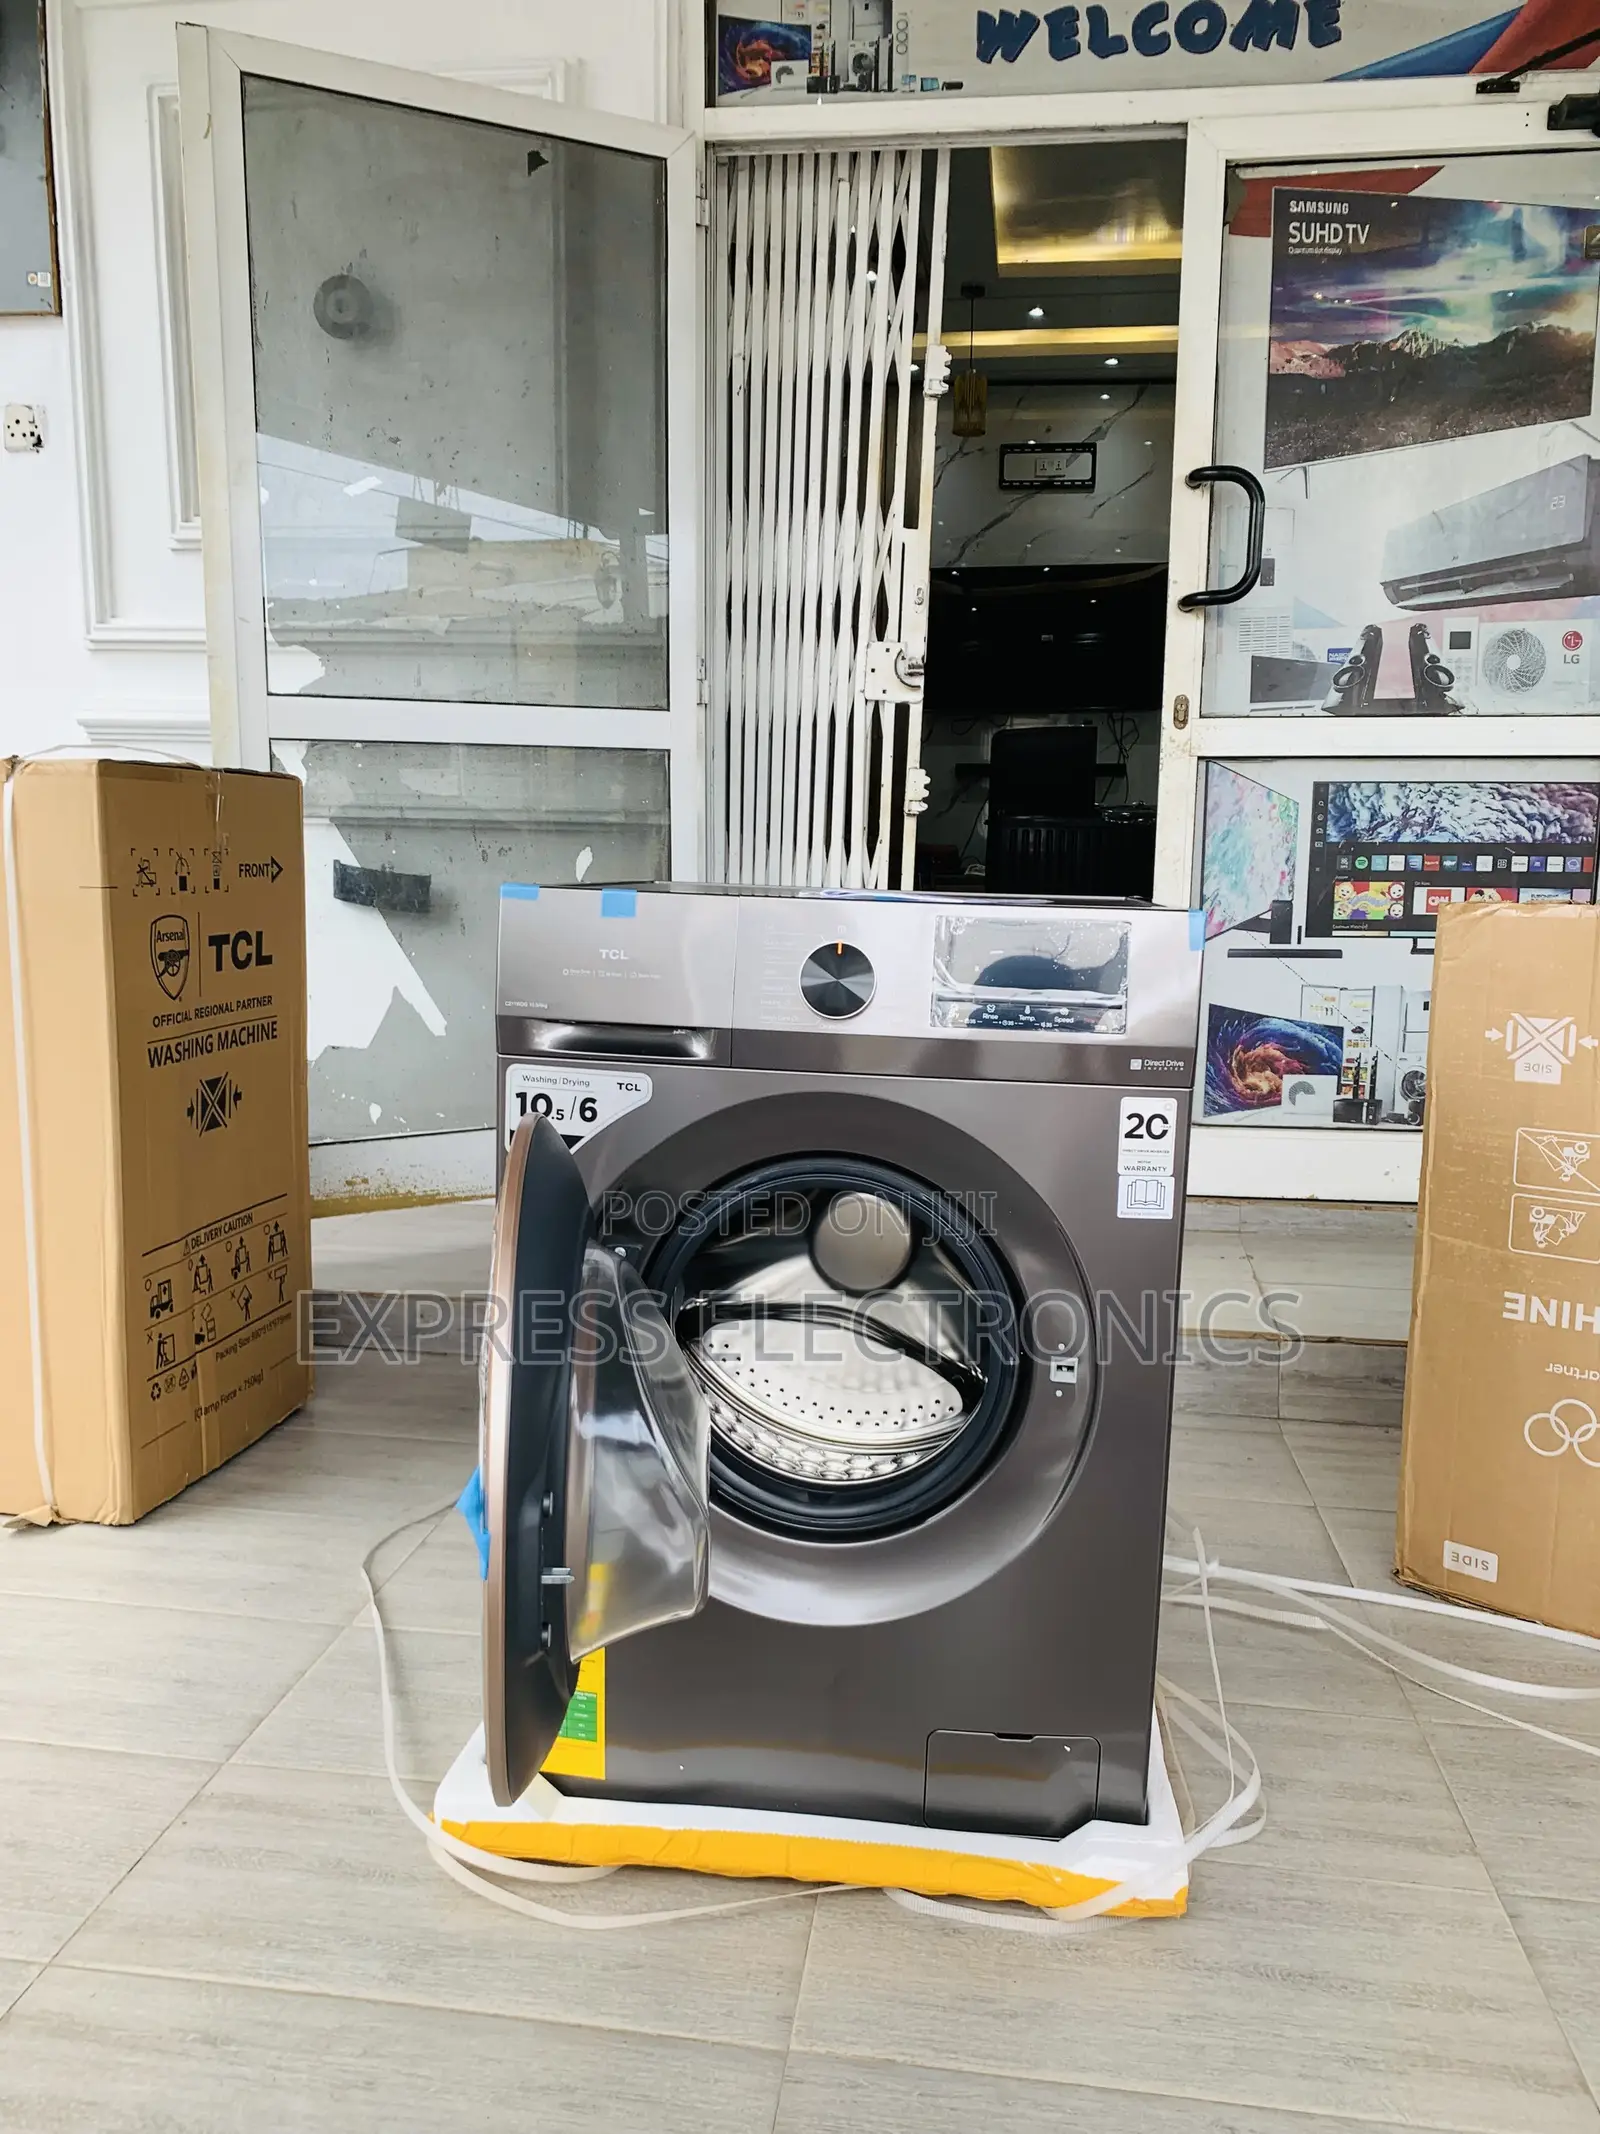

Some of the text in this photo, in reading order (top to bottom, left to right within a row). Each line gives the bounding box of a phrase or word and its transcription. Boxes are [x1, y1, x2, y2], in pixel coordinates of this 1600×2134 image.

[976, 0, 1342, 64] WELCOME
[1289, 200, 1349, 215] SAMSUNG
[1563, 653, 1580, 665] LG
[239, 863, 271, 878] FRONT
[156, 928, 185, 943] Arsenal
[208, 930, 273, 972] TCL
[599, 949, 630, 960] TCL
[152, 995, 273, 1028] OFFICIAL REGIONAL PARTNER
[147, 1020, 278, 1069] WASHING MACHINE
[1144, 1059, 1185, 1067] Direct Drive
[1523, 1062, 1553, 1074] SIDE
[617, 1082, 641, 1092] TCL
[191, 1212, 253, 1251] DELIVERY CAUTION
[1451, 1550, 1489, 1572] SIDE
